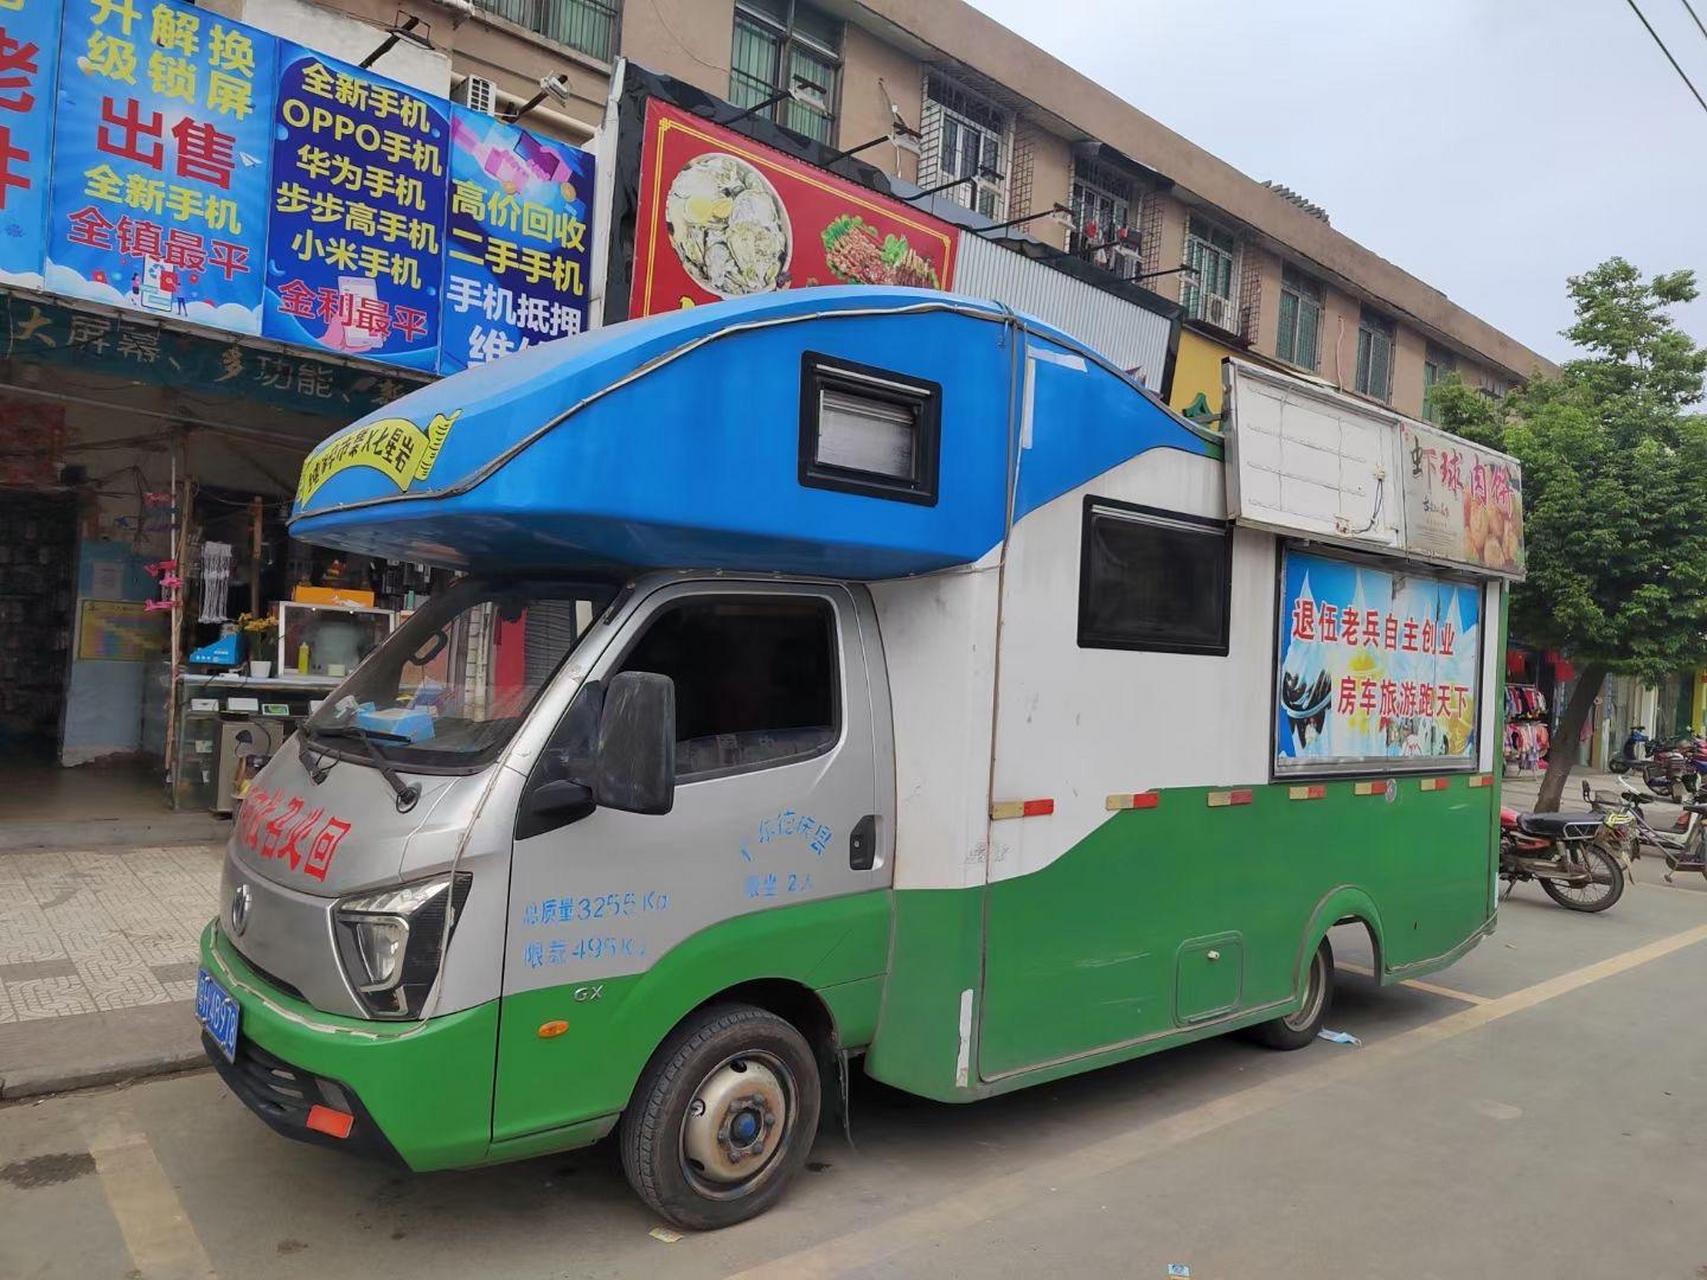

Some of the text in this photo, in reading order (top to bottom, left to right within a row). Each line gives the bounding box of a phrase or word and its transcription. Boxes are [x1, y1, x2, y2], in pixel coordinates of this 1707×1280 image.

[86, 0, 143, 86] 升级
[148, 4, 201, 104] 解锁
[206, 23, 256, 121] 换屏
[301, 62, 431, 133] 全新手机
[97, 95, 236, 190] 出售
[282, 99, 443, 176] OPPO手机
[83, 164, 242, 235] 全新手机
[296, 143, 426, 211] 华为手机
[66, 205, 250, 281] 全镇最平
[276, 181, 440, 255] 步步高手机
[451, 178, 587, 253] 高价回收
[291, 229, 423, 290] 小米手机
[450, 227, 585, 297] 二手手机
[277, 277, 429, 343] 金利最平
[446, 275, 583, 337] 手机抵押
[1292, 600, 1456, 656] 退伍老兵自主创业
[1337, 676, 1470, 719] 房车旅游跑天下
[574, 985, 604, 1002] GX
